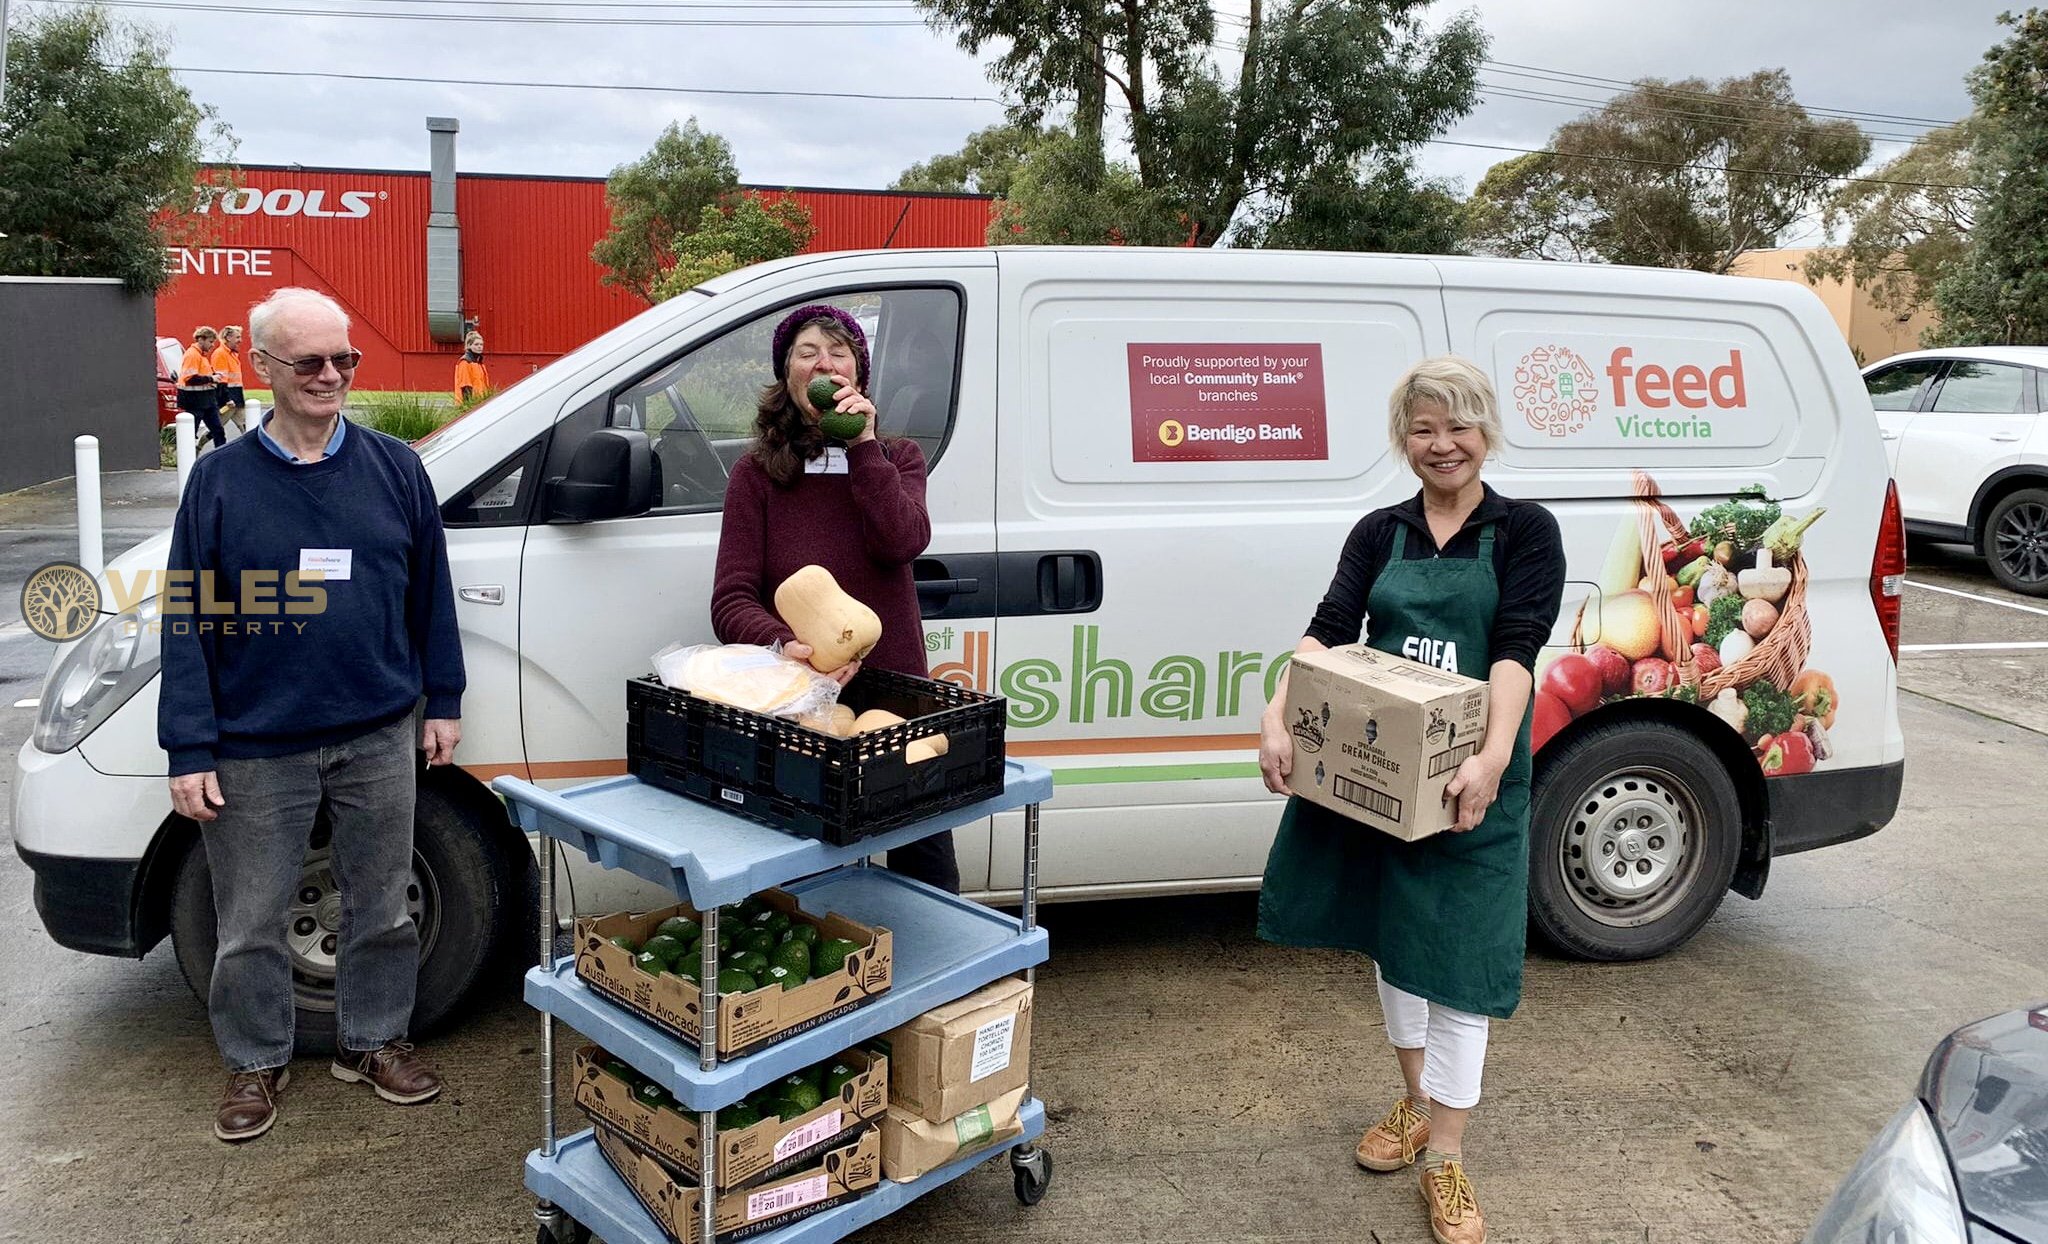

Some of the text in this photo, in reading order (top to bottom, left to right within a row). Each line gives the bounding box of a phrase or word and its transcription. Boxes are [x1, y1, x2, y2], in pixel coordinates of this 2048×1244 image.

[160, 246, 272, 276] ENTRE
[1143, 355, 1309, 369] Proudly supported by your
[1150, 372, 1180, 385] local
[1184, 372, 1259, 387] Community
[1606, 346, 1748, 409] feed
[1199, 389, 1258, 402] branches
[1187, 424, 1304, 444] Bendigo Bank
[1615, 415, 1712, 438] Victoria
[925, 626, 955, 652] st
[1341, 743, 1371, 762] CREAM
[1371, 754, 1401, 774] CHEESE
[584, 963, 631, 999] Australian
[655, 1002, 700, 1036] Avocado
[767, 1019, 816, 1045] AUSTRALIAN
[818, 1002, 859, 1023] AVOCADOS
[583, 1092, 631, 1130] Australian
[654, 1134, 700, 1171] Avocado
[764, 1149, 813, 1178] AUSTRALIAN
[814, 1129, 854, 1152] AVOCADOS
[732, 1214, 789, 1238] AUSTRALIAN
[791, 1198, 839, 1219] AVOCADOS
[764, 1202, 775, 1210] 20
